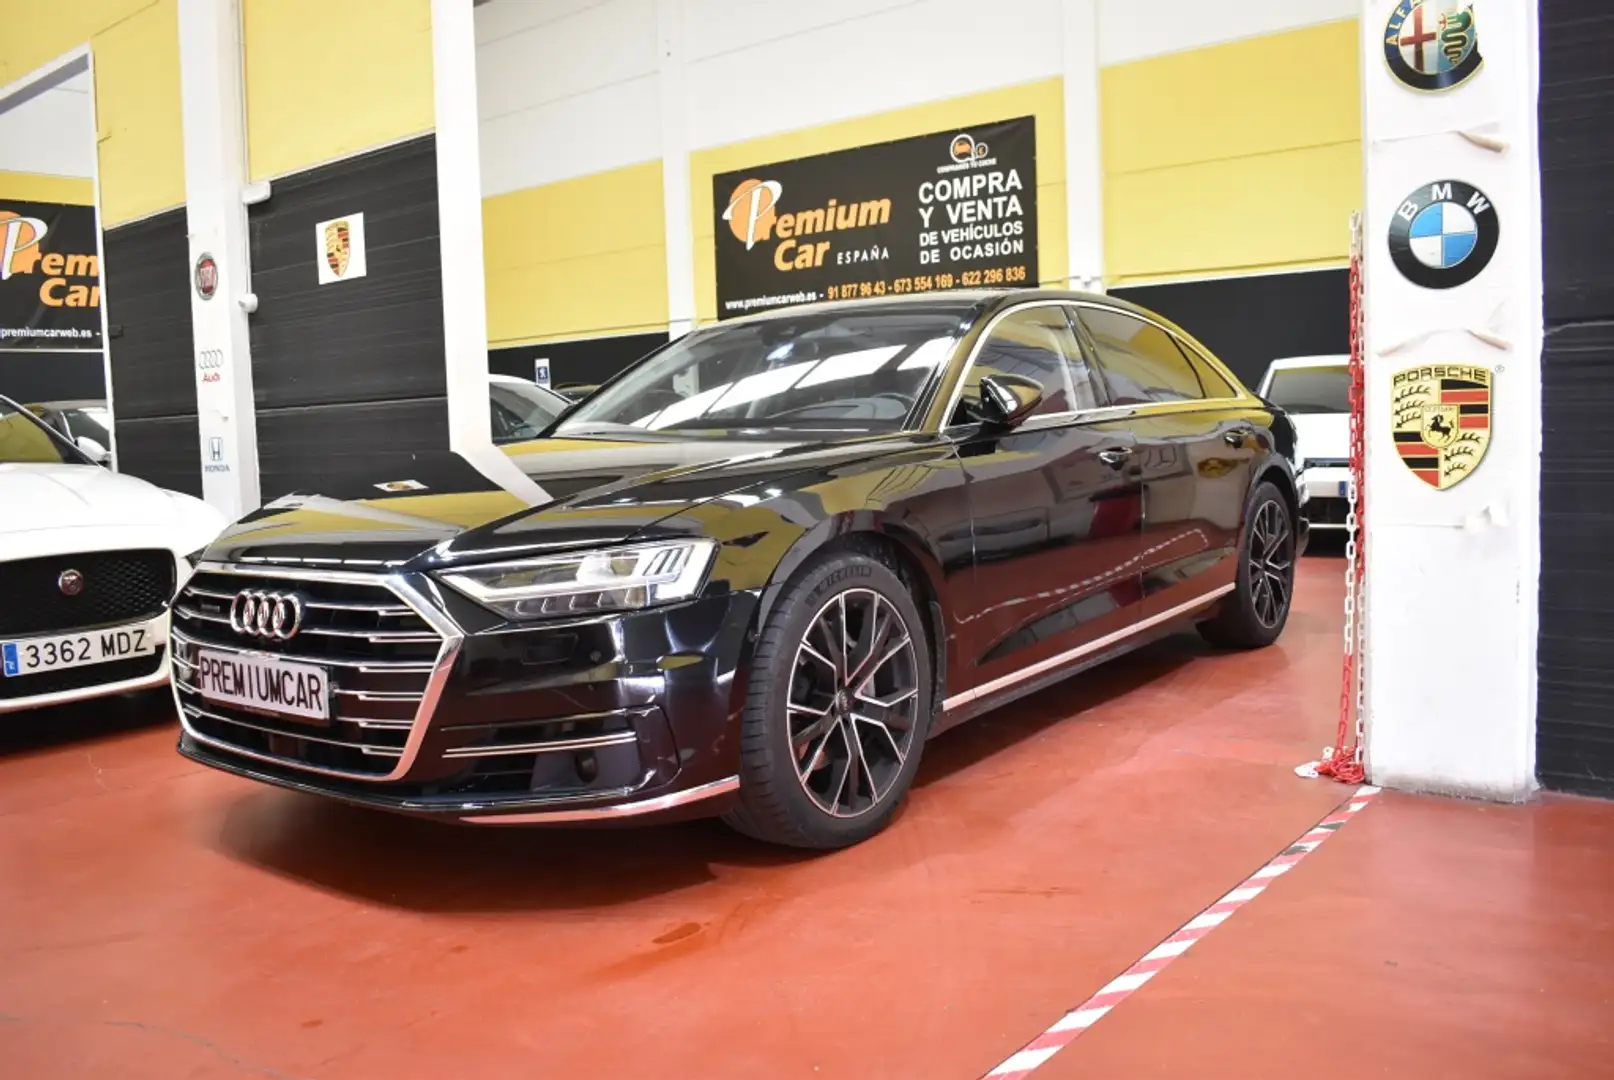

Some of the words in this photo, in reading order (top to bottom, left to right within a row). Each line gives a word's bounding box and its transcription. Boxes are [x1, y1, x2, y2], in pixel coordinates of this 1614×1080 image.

[919, 169, 1023, 204] COMPRA
[1398, 182, 1490, 221] BMW
[722, 180, 892, 251] Premium
[918, 206, 934, 228] Y
[946, 194, 1023, 225] VENTA
[919, 231, 938, 247] DE
[941, 220, 1023, 244] VEHÍCULOS
[920, 249, 940, 264] DE
[950, 237, 1024, 260] OCASIÓN
[774, 239, 831, 271] Car
[837, 244, 889, 265] ESPAÑA
[827, 286, 838, 299] 91
[841, 283, 858, 298] 877
[873, 281, 886, 294] 43
[894, 278, 912, 293] 673
[914, 276, 932, 291] 554
[962, 271, 981, 286] 622
[984, 268, 1003, 284] 296
[1005, 266, 1026, 282] 836
[1393, 367, 1486, 387] PORSCHE
[26, 638, 91, 668] 3362
[100, 629, 146, 658] MDZ
[200, 656, 322, 711] PREMIUMCAR
